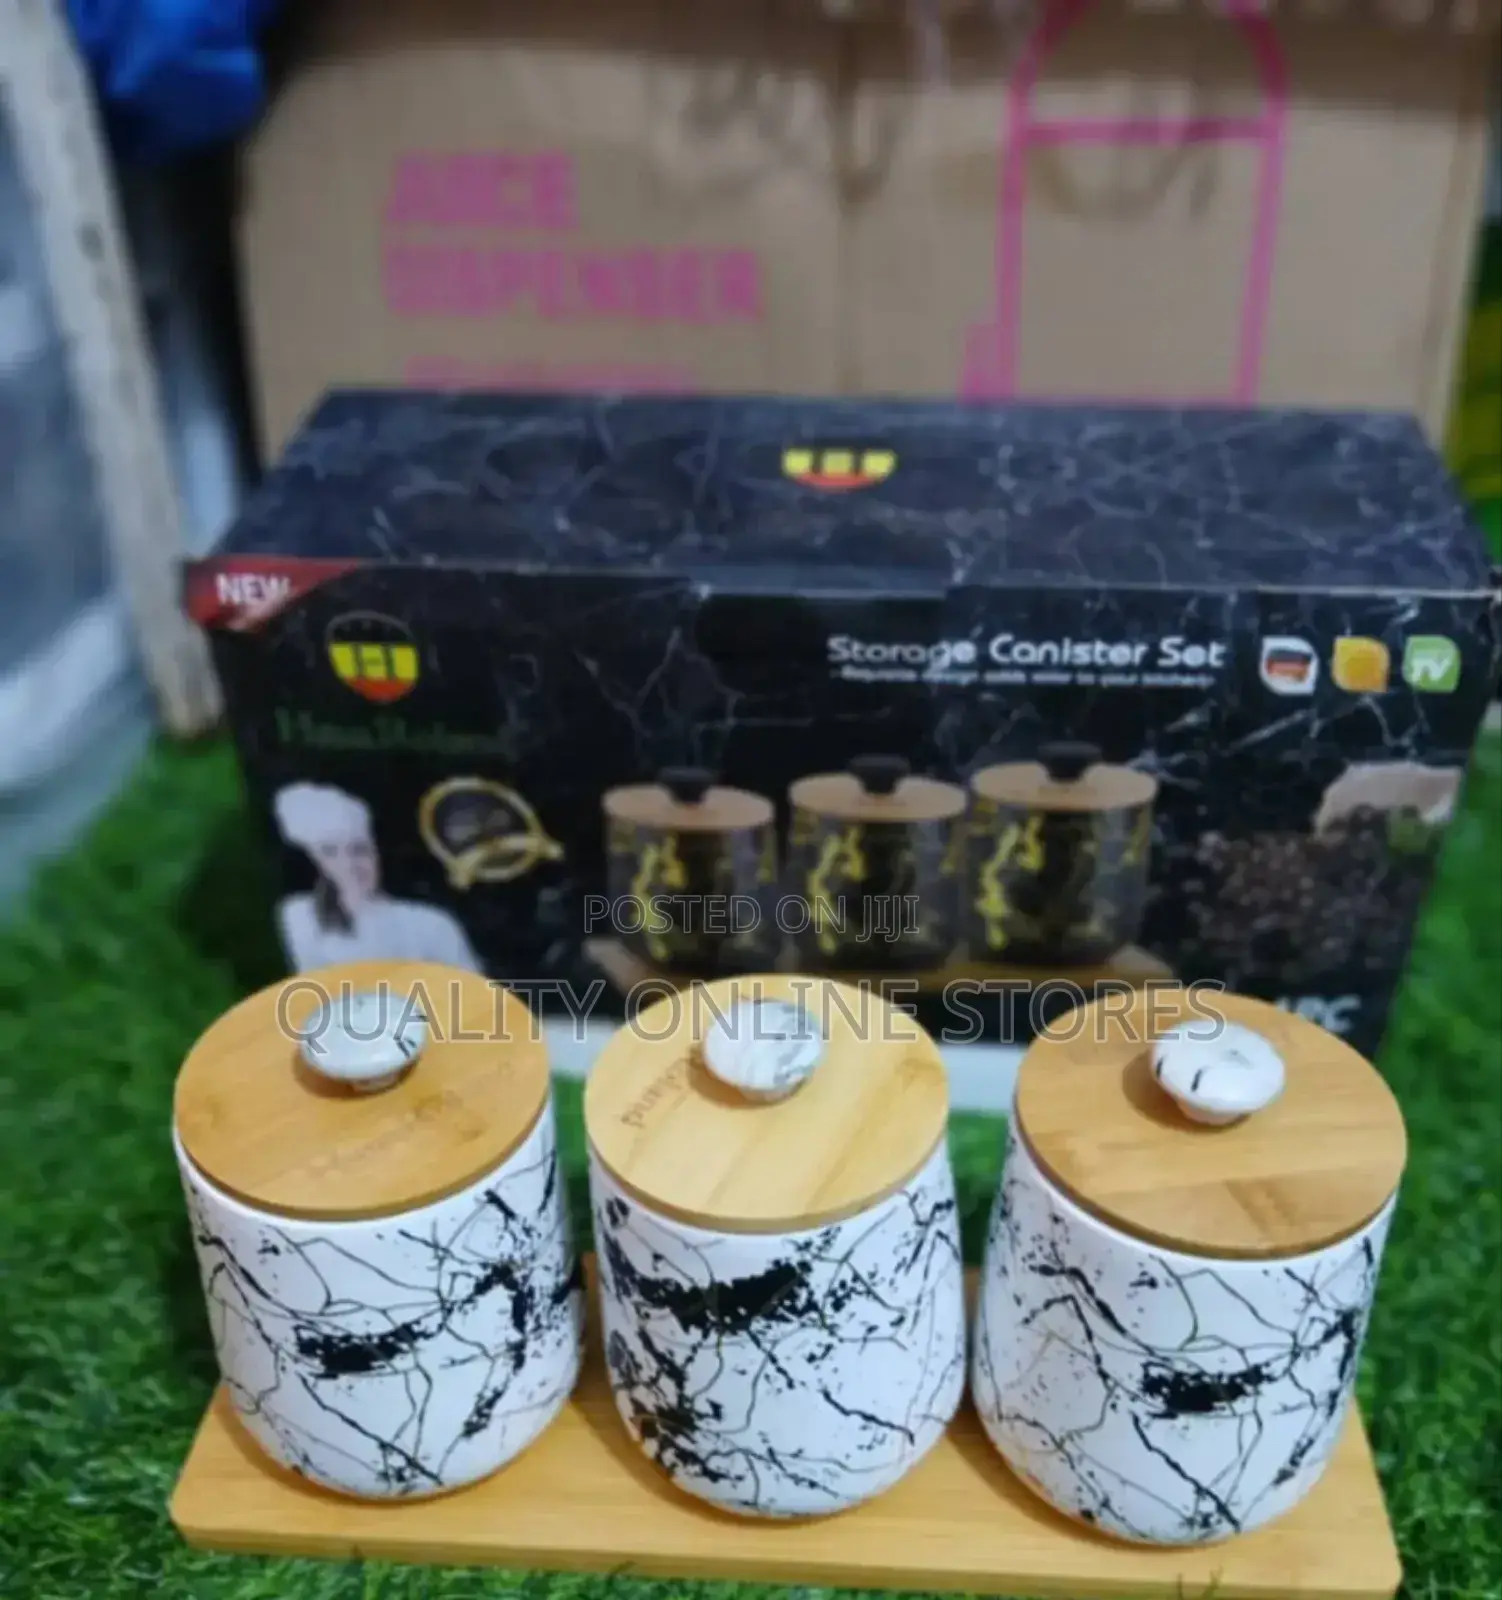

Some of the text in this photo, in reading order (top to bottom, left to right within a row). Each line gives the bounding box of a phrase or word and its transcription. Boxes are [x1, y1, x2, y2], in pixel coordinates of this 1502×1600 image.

[215, 571, 291, 605] NEW
[827, 634, 1227, 669] Storage Canister Set
